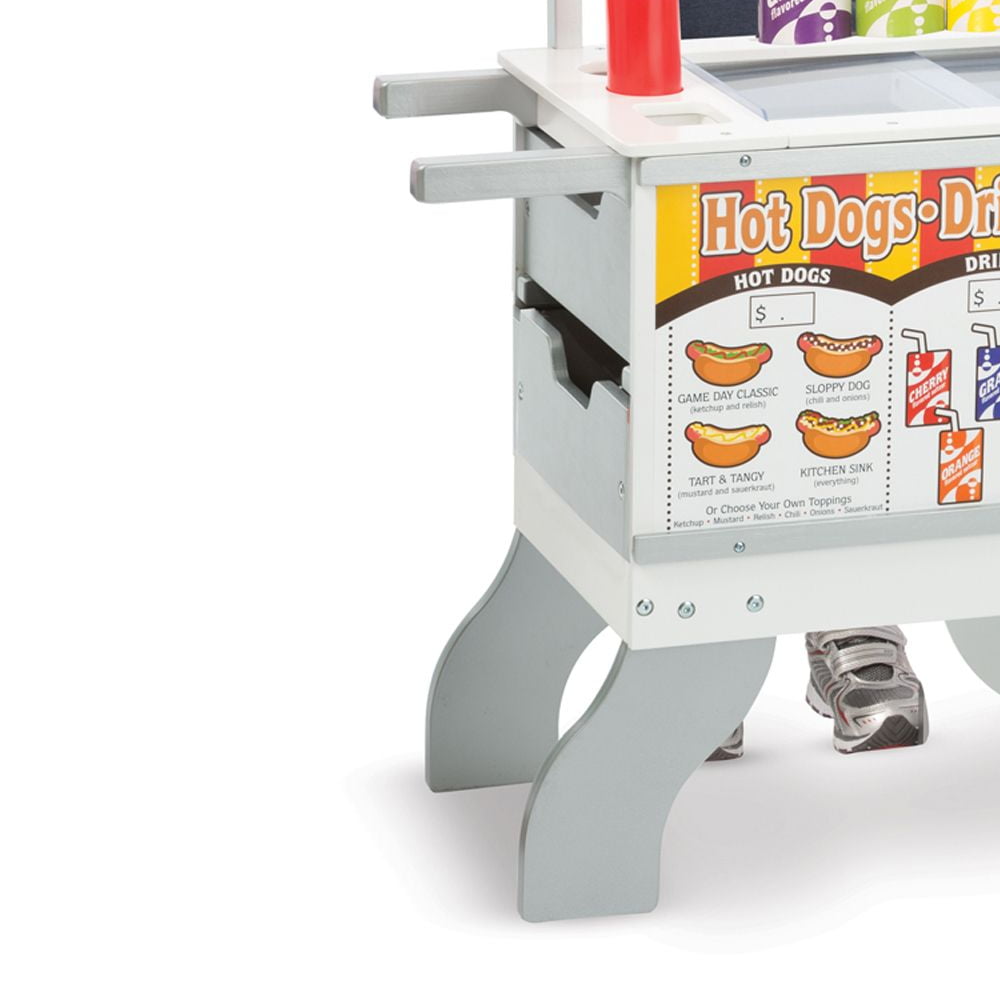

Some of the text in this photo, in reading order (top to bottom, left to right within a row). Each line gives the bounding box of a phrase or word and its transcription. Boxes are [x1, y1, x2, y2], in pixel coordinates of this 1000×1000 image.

[700, 191, 792, 257] Hot
[801, 185, 918, 262] Dogs
[734, 266, 832, 291] HOT DOGS
[805, 379, 871, 394] SLOPPY DOG
[908, 367, 949, 404] CHERRY
[678, 386, 779, 404] GAME DAY CLASSIC
[805, 392, 870, 406] (chili and onions)
[690, 399, 767, 415] (ketchup and relish)
[799, 462, 874, 478] KITCHEN SINK
[941, 444, 981, 480] ORANGE
[688, 471, 765, 488] TART & TANGY
[813, 476, 860, 489] (everything)
[677, 482, 775, 500] (mustard and sauerkraut)
[705, 494, 852, 516] Or Choose Your Own Toppings
[673, 503, 884, 529] Ketchup Mustard Relish Chili Onions Sauerkraut
